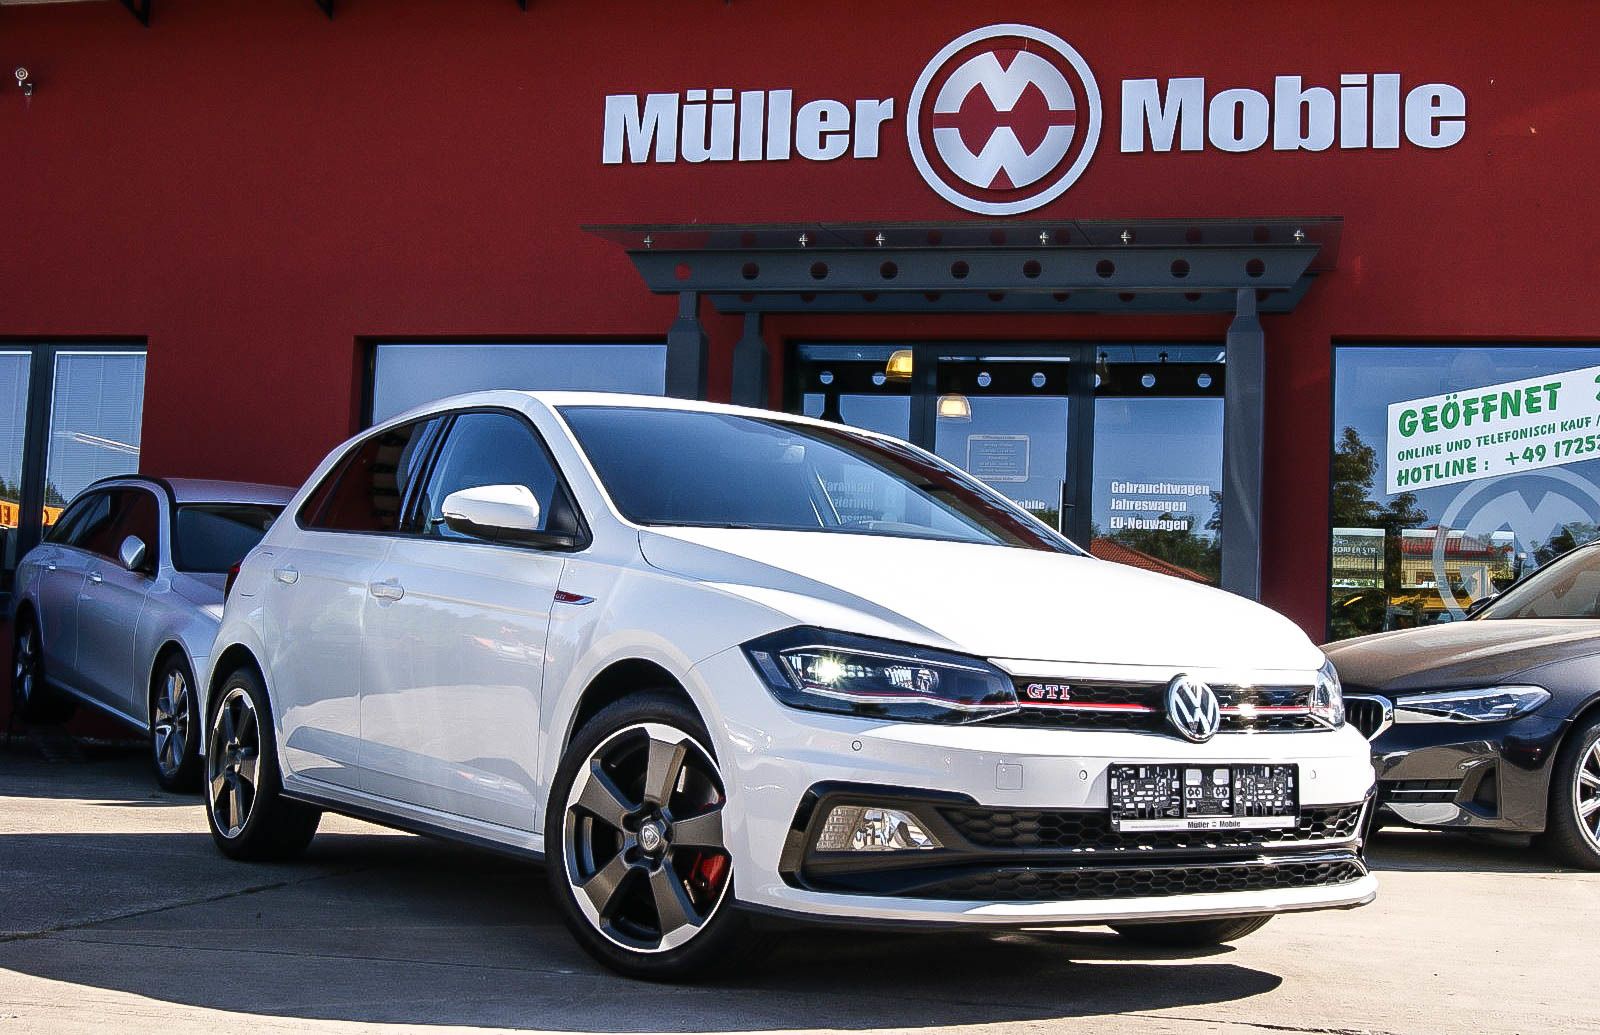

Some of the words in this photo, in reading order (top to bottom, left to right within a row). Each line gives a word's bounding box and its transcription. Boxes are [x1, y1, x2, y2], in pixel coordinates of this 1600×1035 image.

[603, 88, 894, 164] Müller
[1120, 73, 1466, 153] Mobile
[1399, 382, 1562, 438] GEÖFFNET
[1397, 444, 1442, 462] ONLINE
[1446, 438, 1472, 453] UND
[1476, 423, 1556, 448] TELEFONISCH
[1560, 416, 1592, 432] KAUF
[1397, 456, 1477, 487] HOTLINE
[1504, 444, 1547, 466] +49
[1111, 481, 1210, 496] Gebrauchtwagen
[1110, 498, 1187, 512] Jahreswagen
[1110, 516, 1188, 531] EU-Neuwagen
[1027, 683, 1070, 700] GTI
